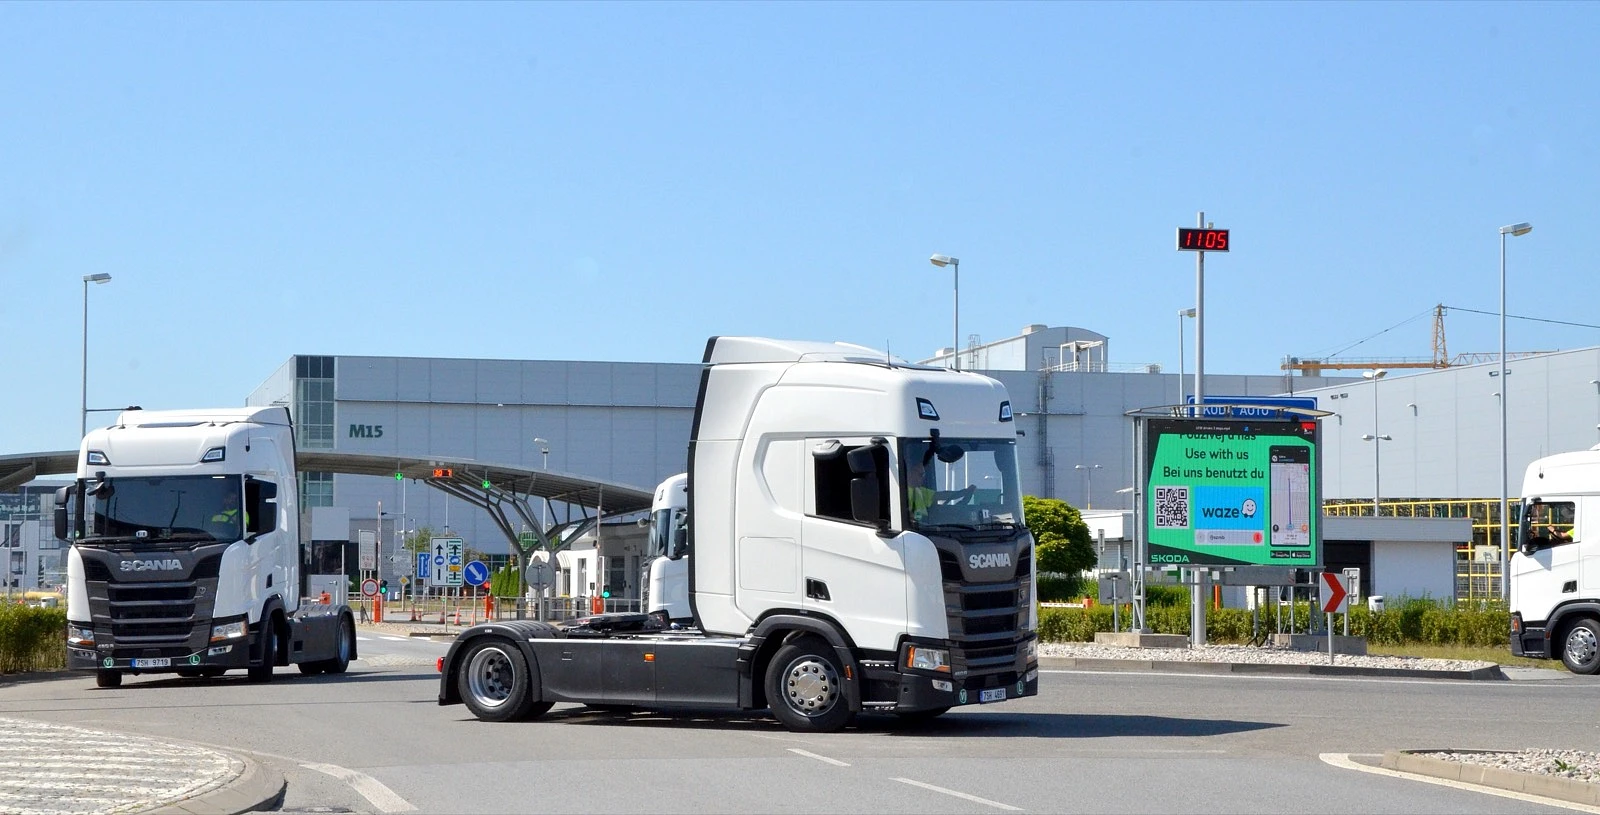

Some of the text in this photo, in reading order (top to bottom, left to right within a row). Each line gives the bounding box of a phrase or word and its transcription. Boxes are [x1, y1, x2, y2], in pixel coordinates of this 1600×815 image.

[349, 424, 384, 438] M15
[1185, 448, 1249, 460] Use with us
[1163, 466, 1264, 479] Bei uns benutzt du
[1202, 508, 1240, 518] waze
[119, 559, 183, 572] SCANIA
[969, 553, 1011, 569] SCANIA
[152, 658, 169, 666] 9719
